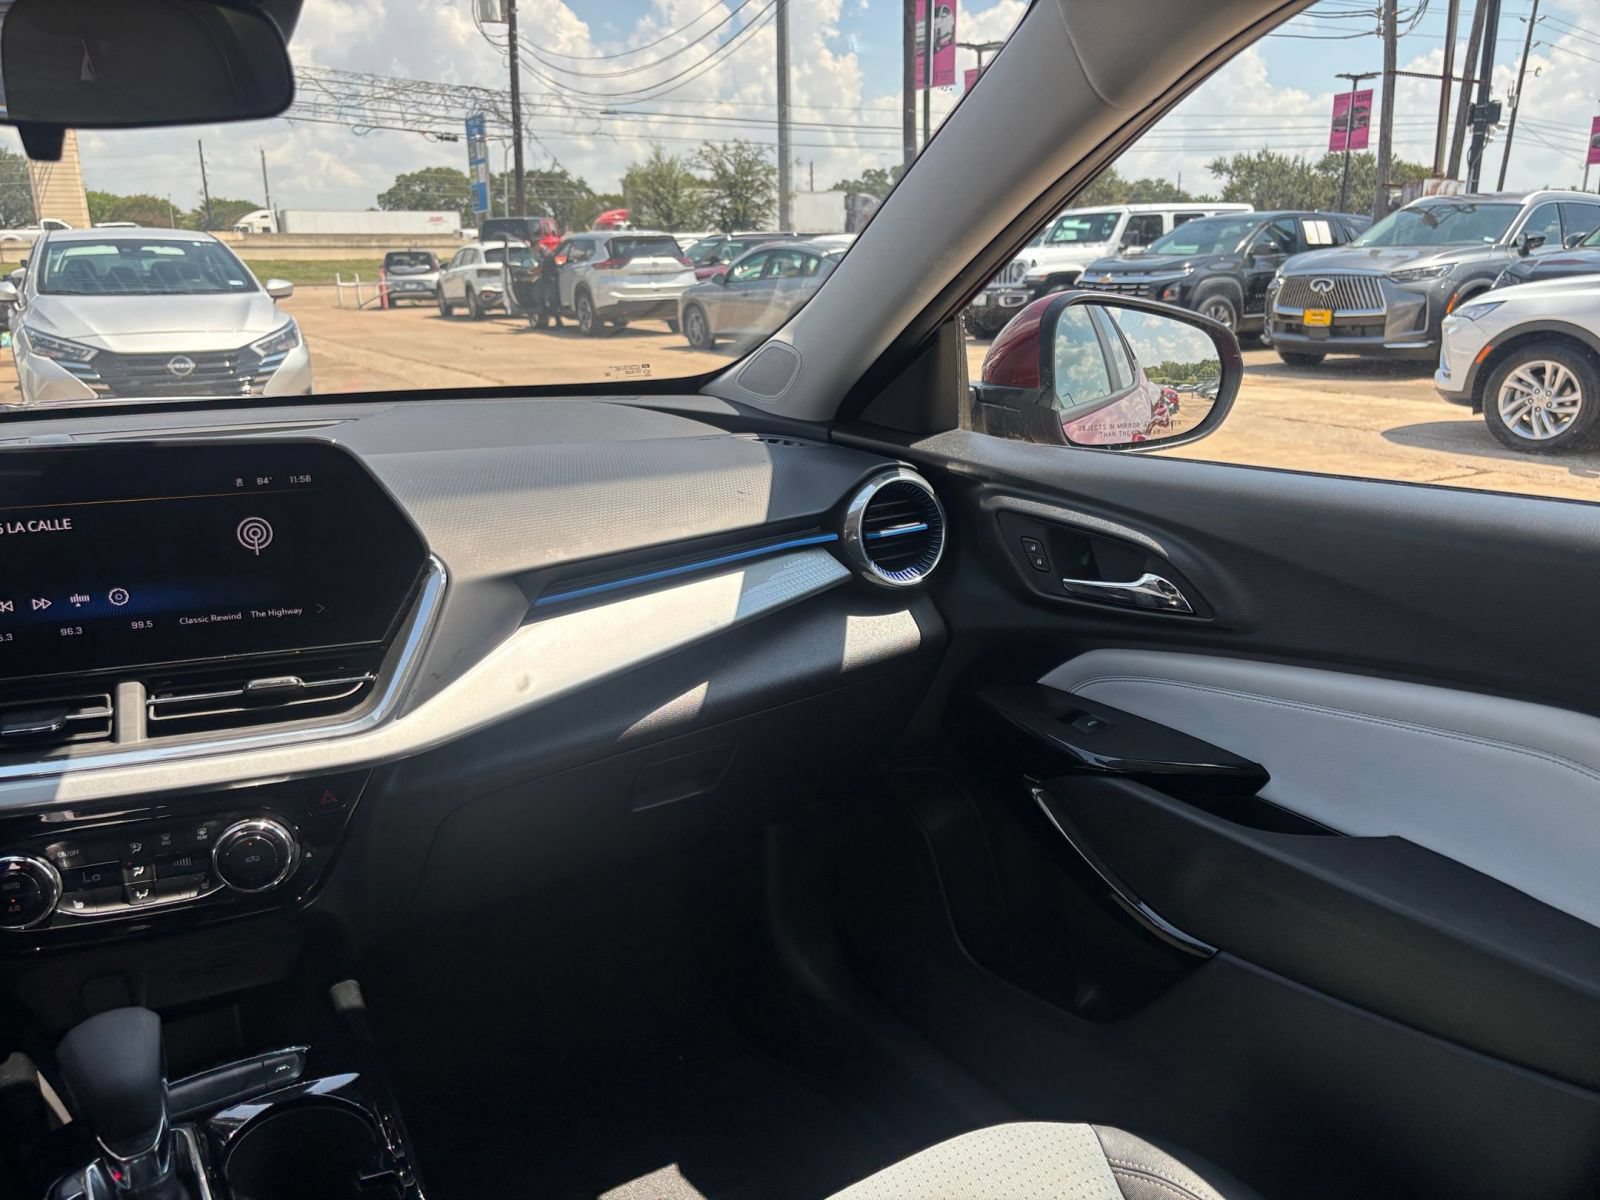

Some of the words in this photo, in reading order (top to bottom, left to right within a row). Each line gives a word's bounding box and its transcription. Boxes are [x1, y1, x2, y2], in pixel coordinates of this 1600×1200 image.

[1077, 423, 1106, 432] OBJECTS
[1109, 422, 1115, 430] IN
[1117, 421, 1141, 430] MIRROR
[1099, 430, 1116, 439] THAN
[289, 474, 312, 484] 11:58
[6, 521, 26, 534] LA
[27, 517, 73, 532] CALLE
[250, 609, 267, 619] The
[268, 606, 303, 619] Highway
[179, 615, 209, 626] Classic
[211, 611, 242, 623] Rewind
[131, 620, 153, 630] 99.5
[60, 626, 83, 637] 96.3
[57, 848, 80, 858] ON/OFF
